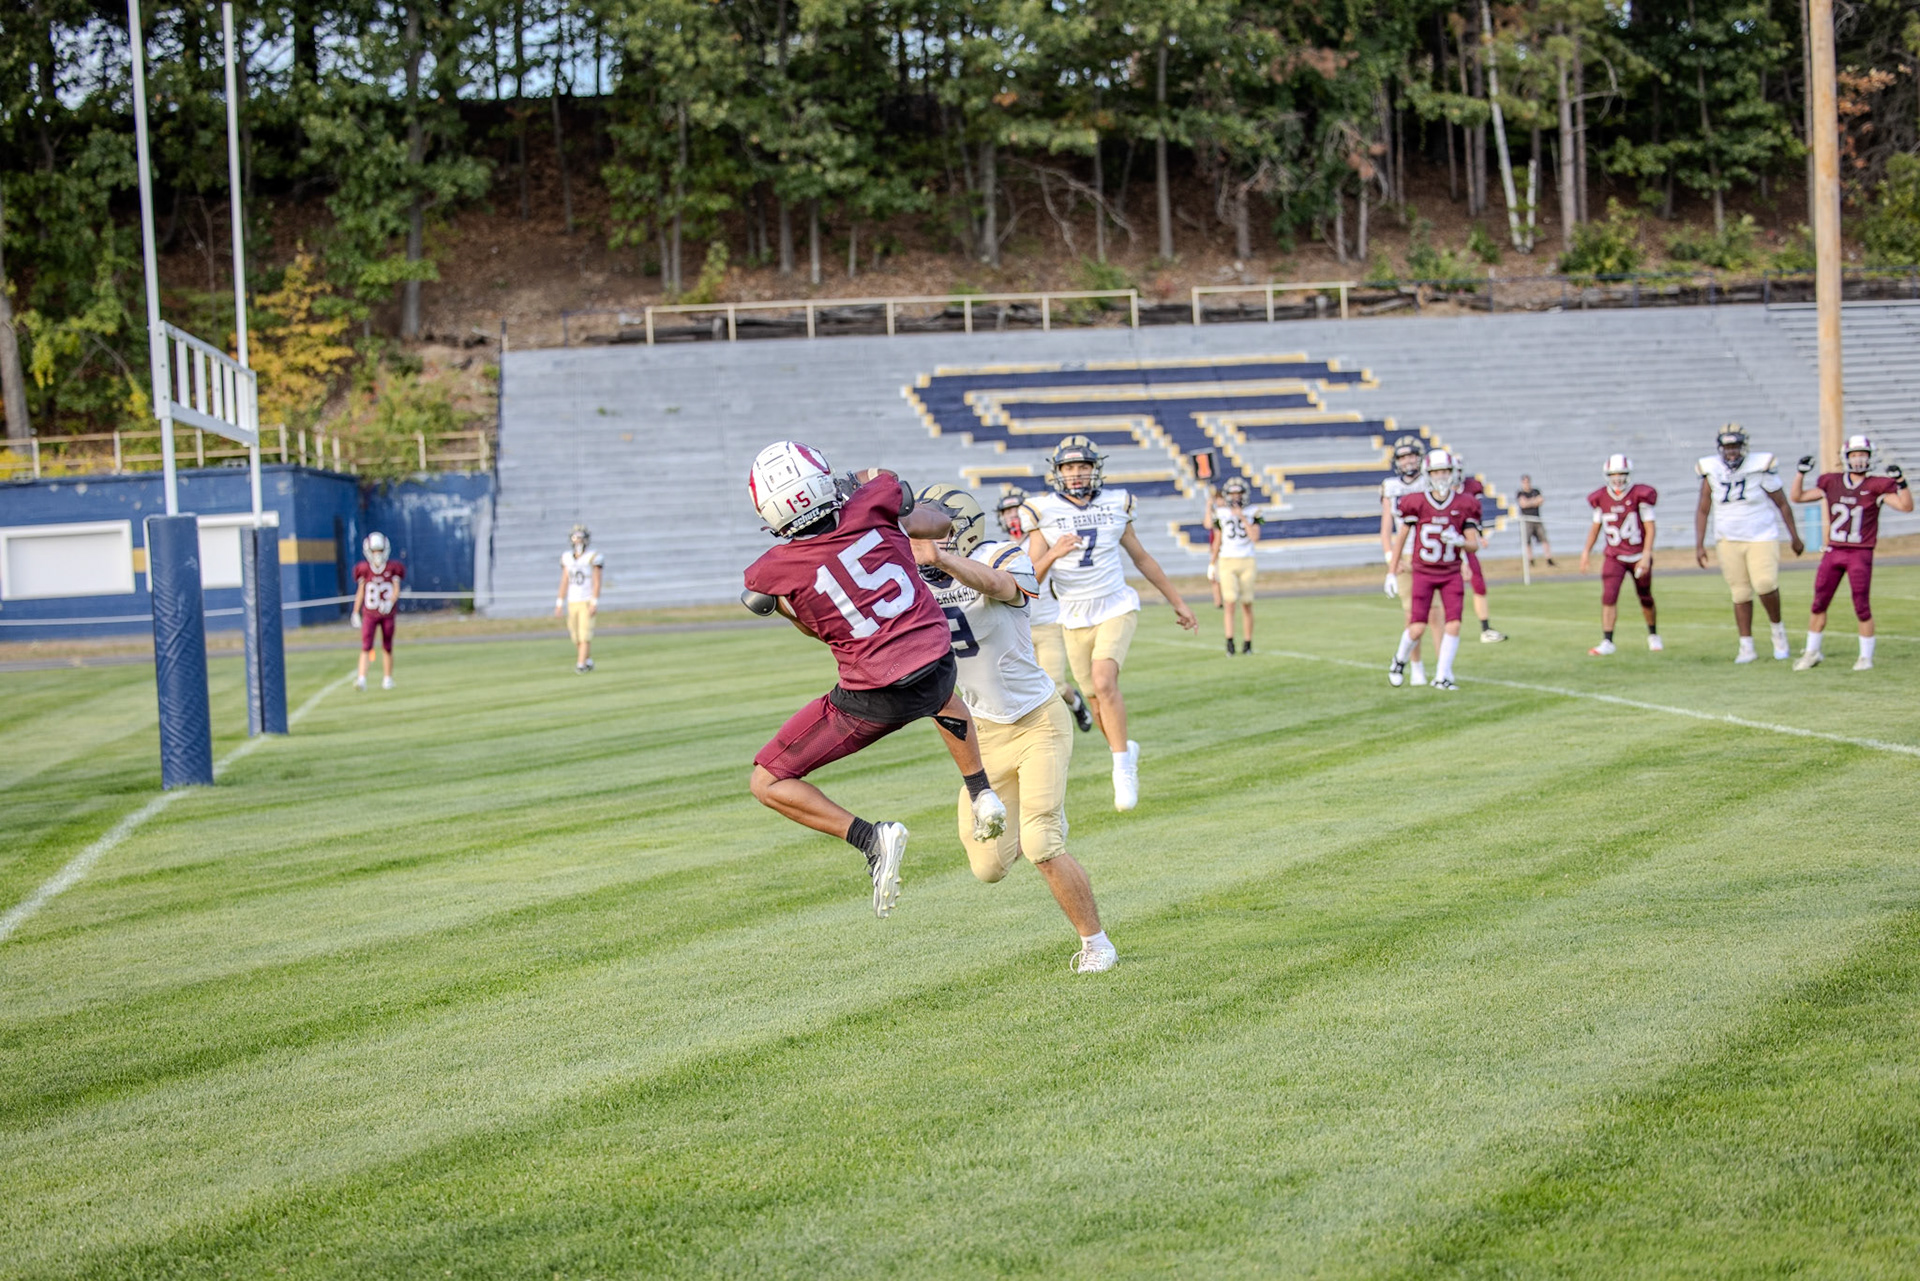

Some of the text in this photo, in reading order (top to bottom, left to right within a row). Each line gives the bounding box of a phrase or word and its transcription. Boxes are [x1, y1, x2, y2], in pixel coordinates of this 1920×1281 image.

[786, 490, 811, 514] 15
[1721, 478, 1746, 503] 77
[1602, 511, 1642, 546] 54
[1829, 503, 1864, 543] 21
[1076, 528, 1098, 567] 7
[813, 528, 915, 639] 15
